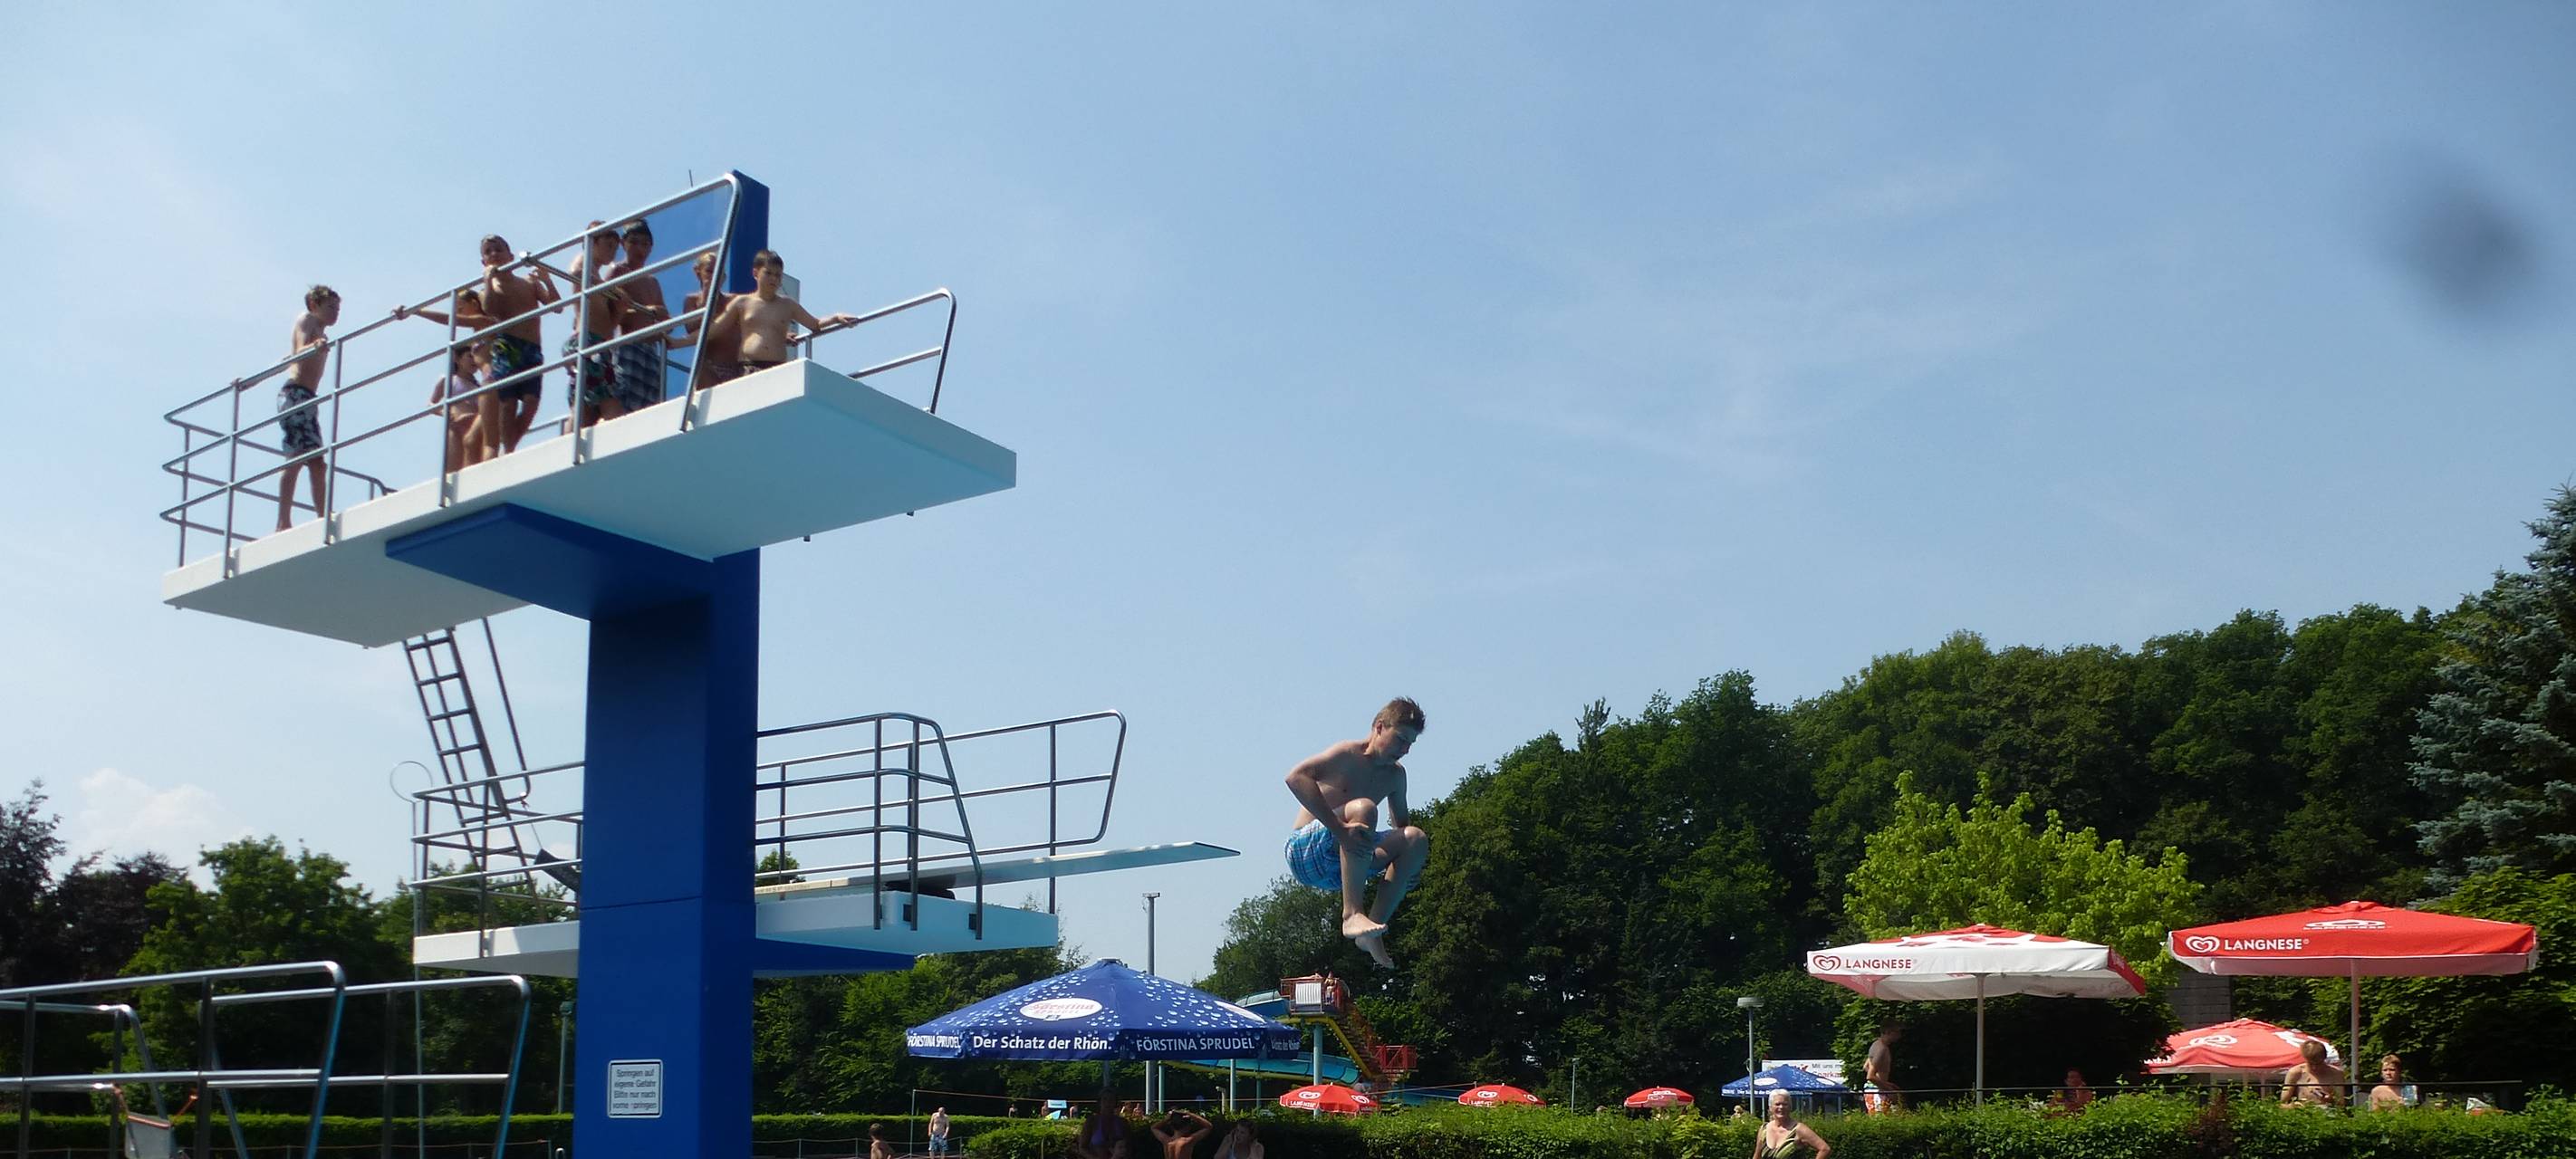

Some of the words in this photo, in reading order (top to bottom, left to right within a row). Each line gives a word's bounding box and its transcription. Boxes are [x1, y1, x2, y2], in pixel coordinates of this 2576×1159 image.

[2224, 939, 2302, 950] LANGNESE
[1846, 959, 1912, 969] LANGNESE
[936, 1035, 960, 1048] SPRUDEL
[974, 1035, 997, 1049] Der
[1001, 1036, 1045, 1049] Schatz
[1048, 1036, 1071, 1049] der
[1074, 1037, 1112, 1049] Rhön.
[1136, 1037, 1197, 1051] FÖRSTINA
[1200, 1038, 1255, 1050] SPRUDEL
